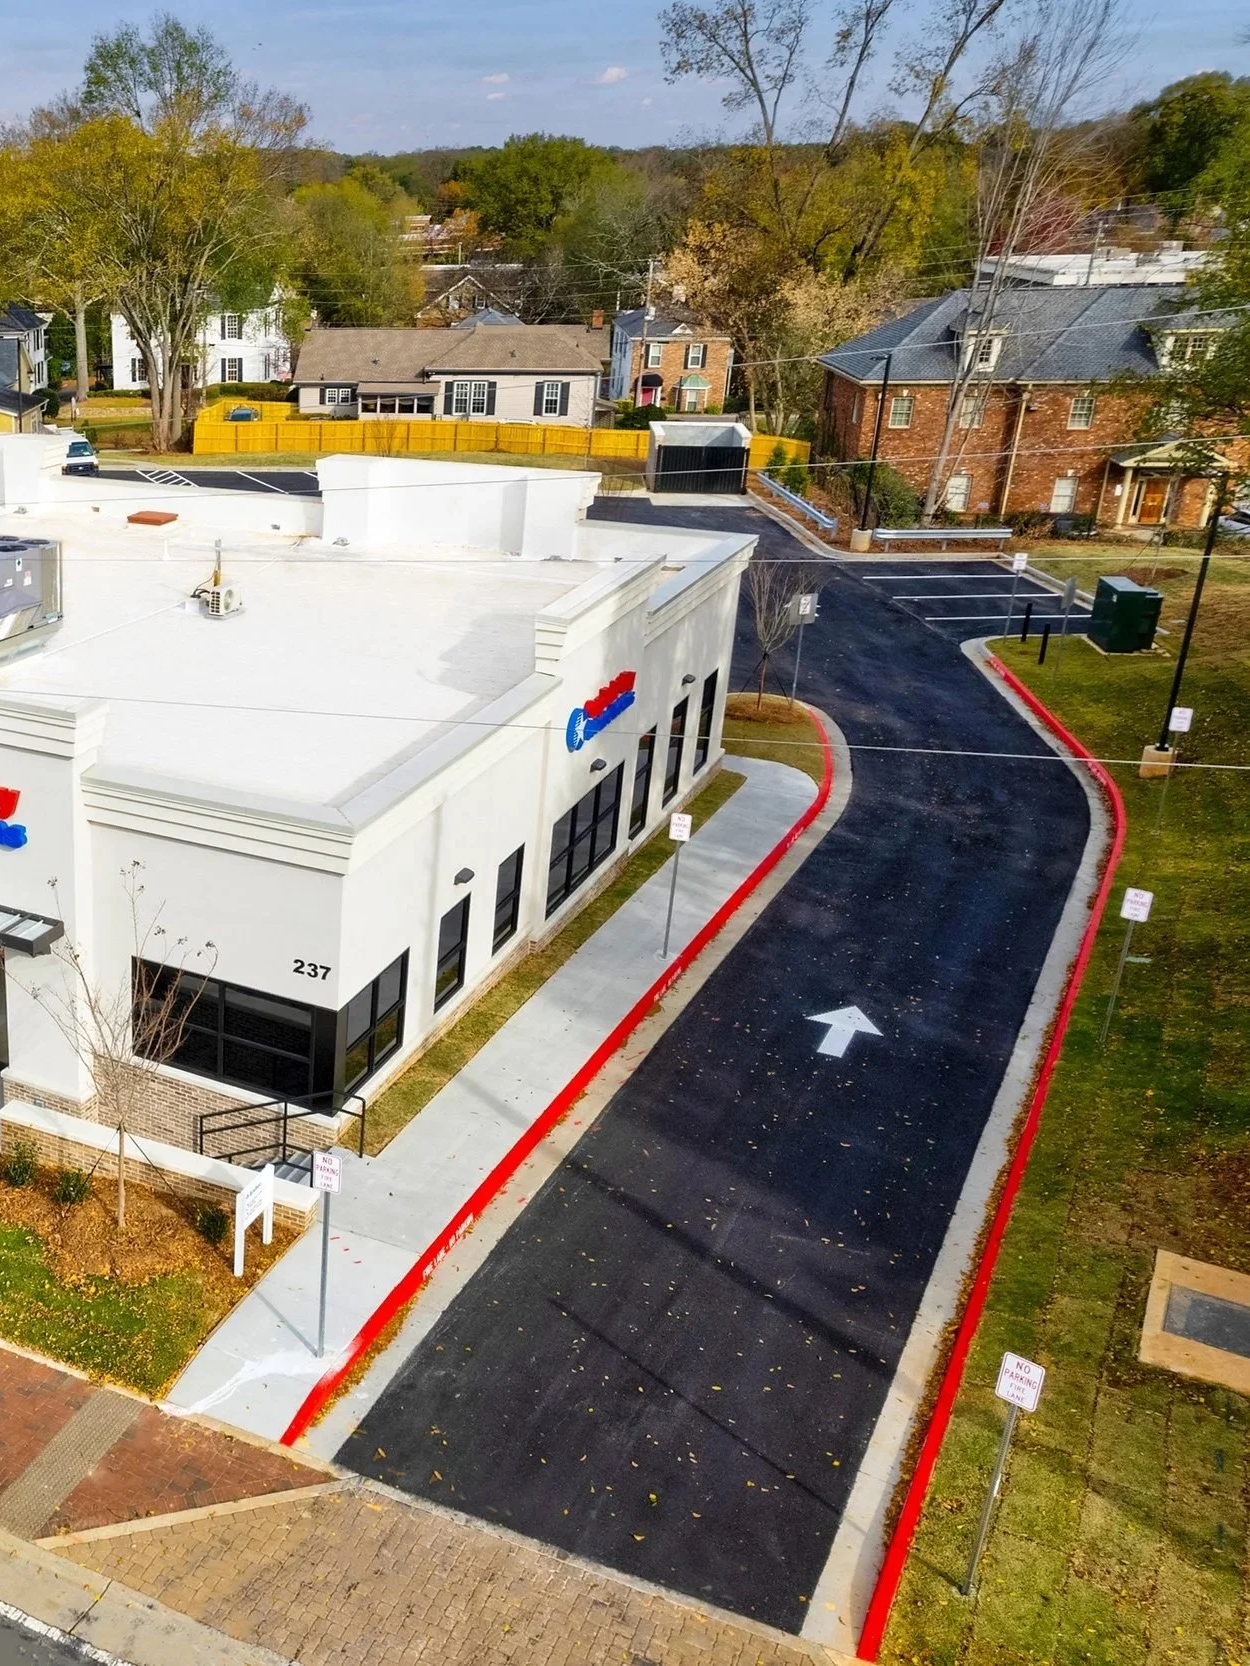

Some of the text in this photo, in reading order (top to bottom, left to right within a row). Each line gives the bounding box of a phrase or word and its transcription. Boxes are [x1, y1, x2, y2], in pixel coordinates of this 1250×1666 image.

[293, 959, 331, 980] 237
[322, 1156, 333, 1166] NO
[316, 1164, 339, 1177] PARKING
[1015, 1361, 1031, 1374] NO
[1004, 1368, 1038, 1390] PARKING
[1010, 1382, 1025, 1394] FIRE
[1007, 1391, 1025, 1402] LANE
